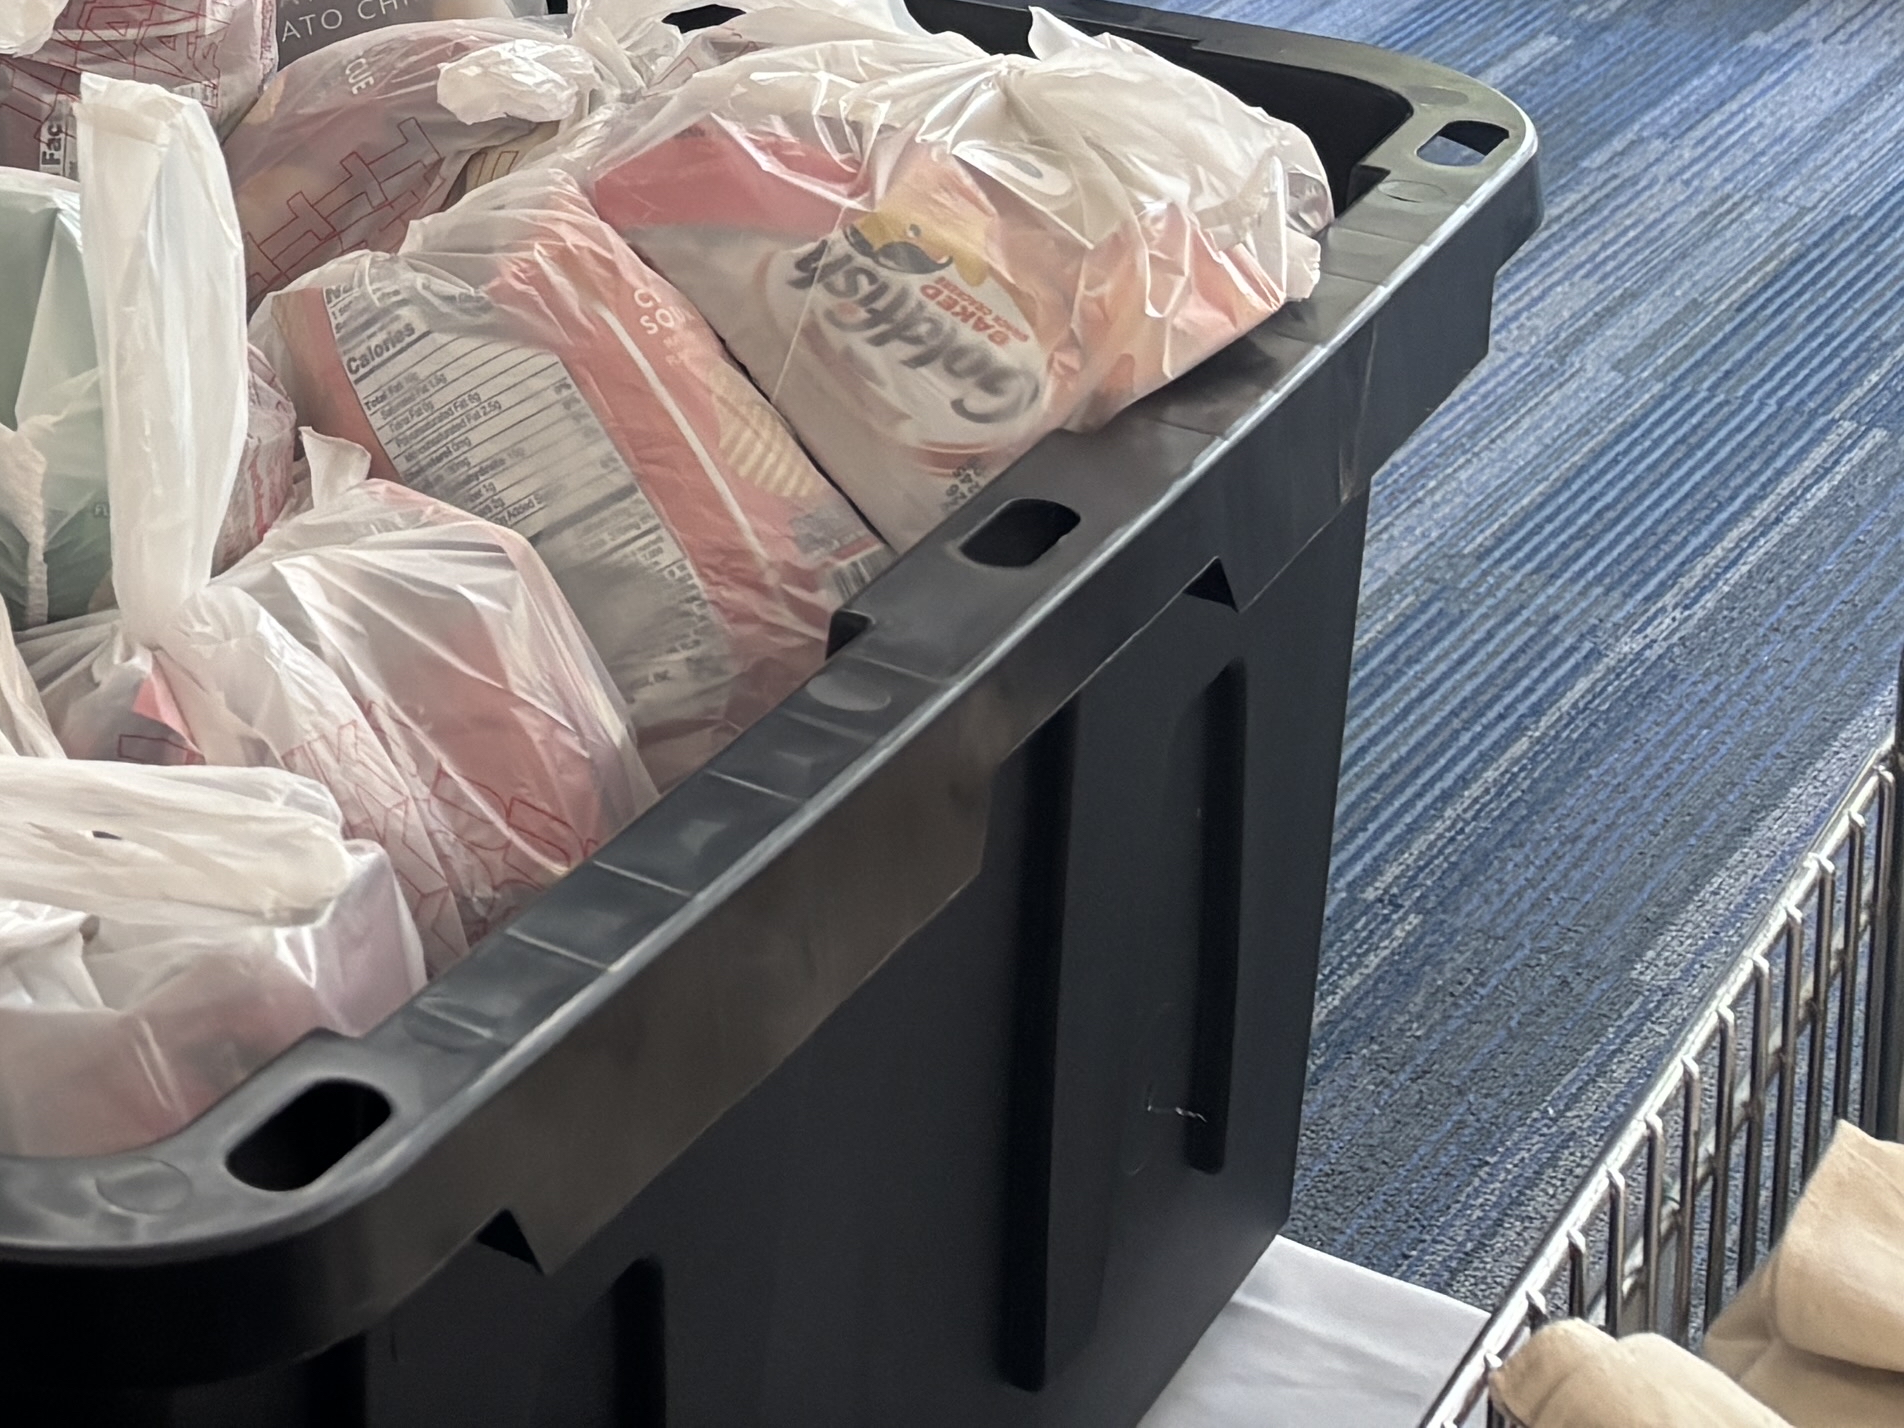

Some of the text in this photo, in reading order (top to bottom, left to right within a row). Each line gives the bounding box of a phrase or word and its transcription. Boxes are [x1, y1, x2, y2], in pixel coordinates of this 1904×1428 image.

[787, 237, 1040, 425] Goldfish
[920, 283, 1011, 346] BAKED
[345, 322, 415, 375] Calories
